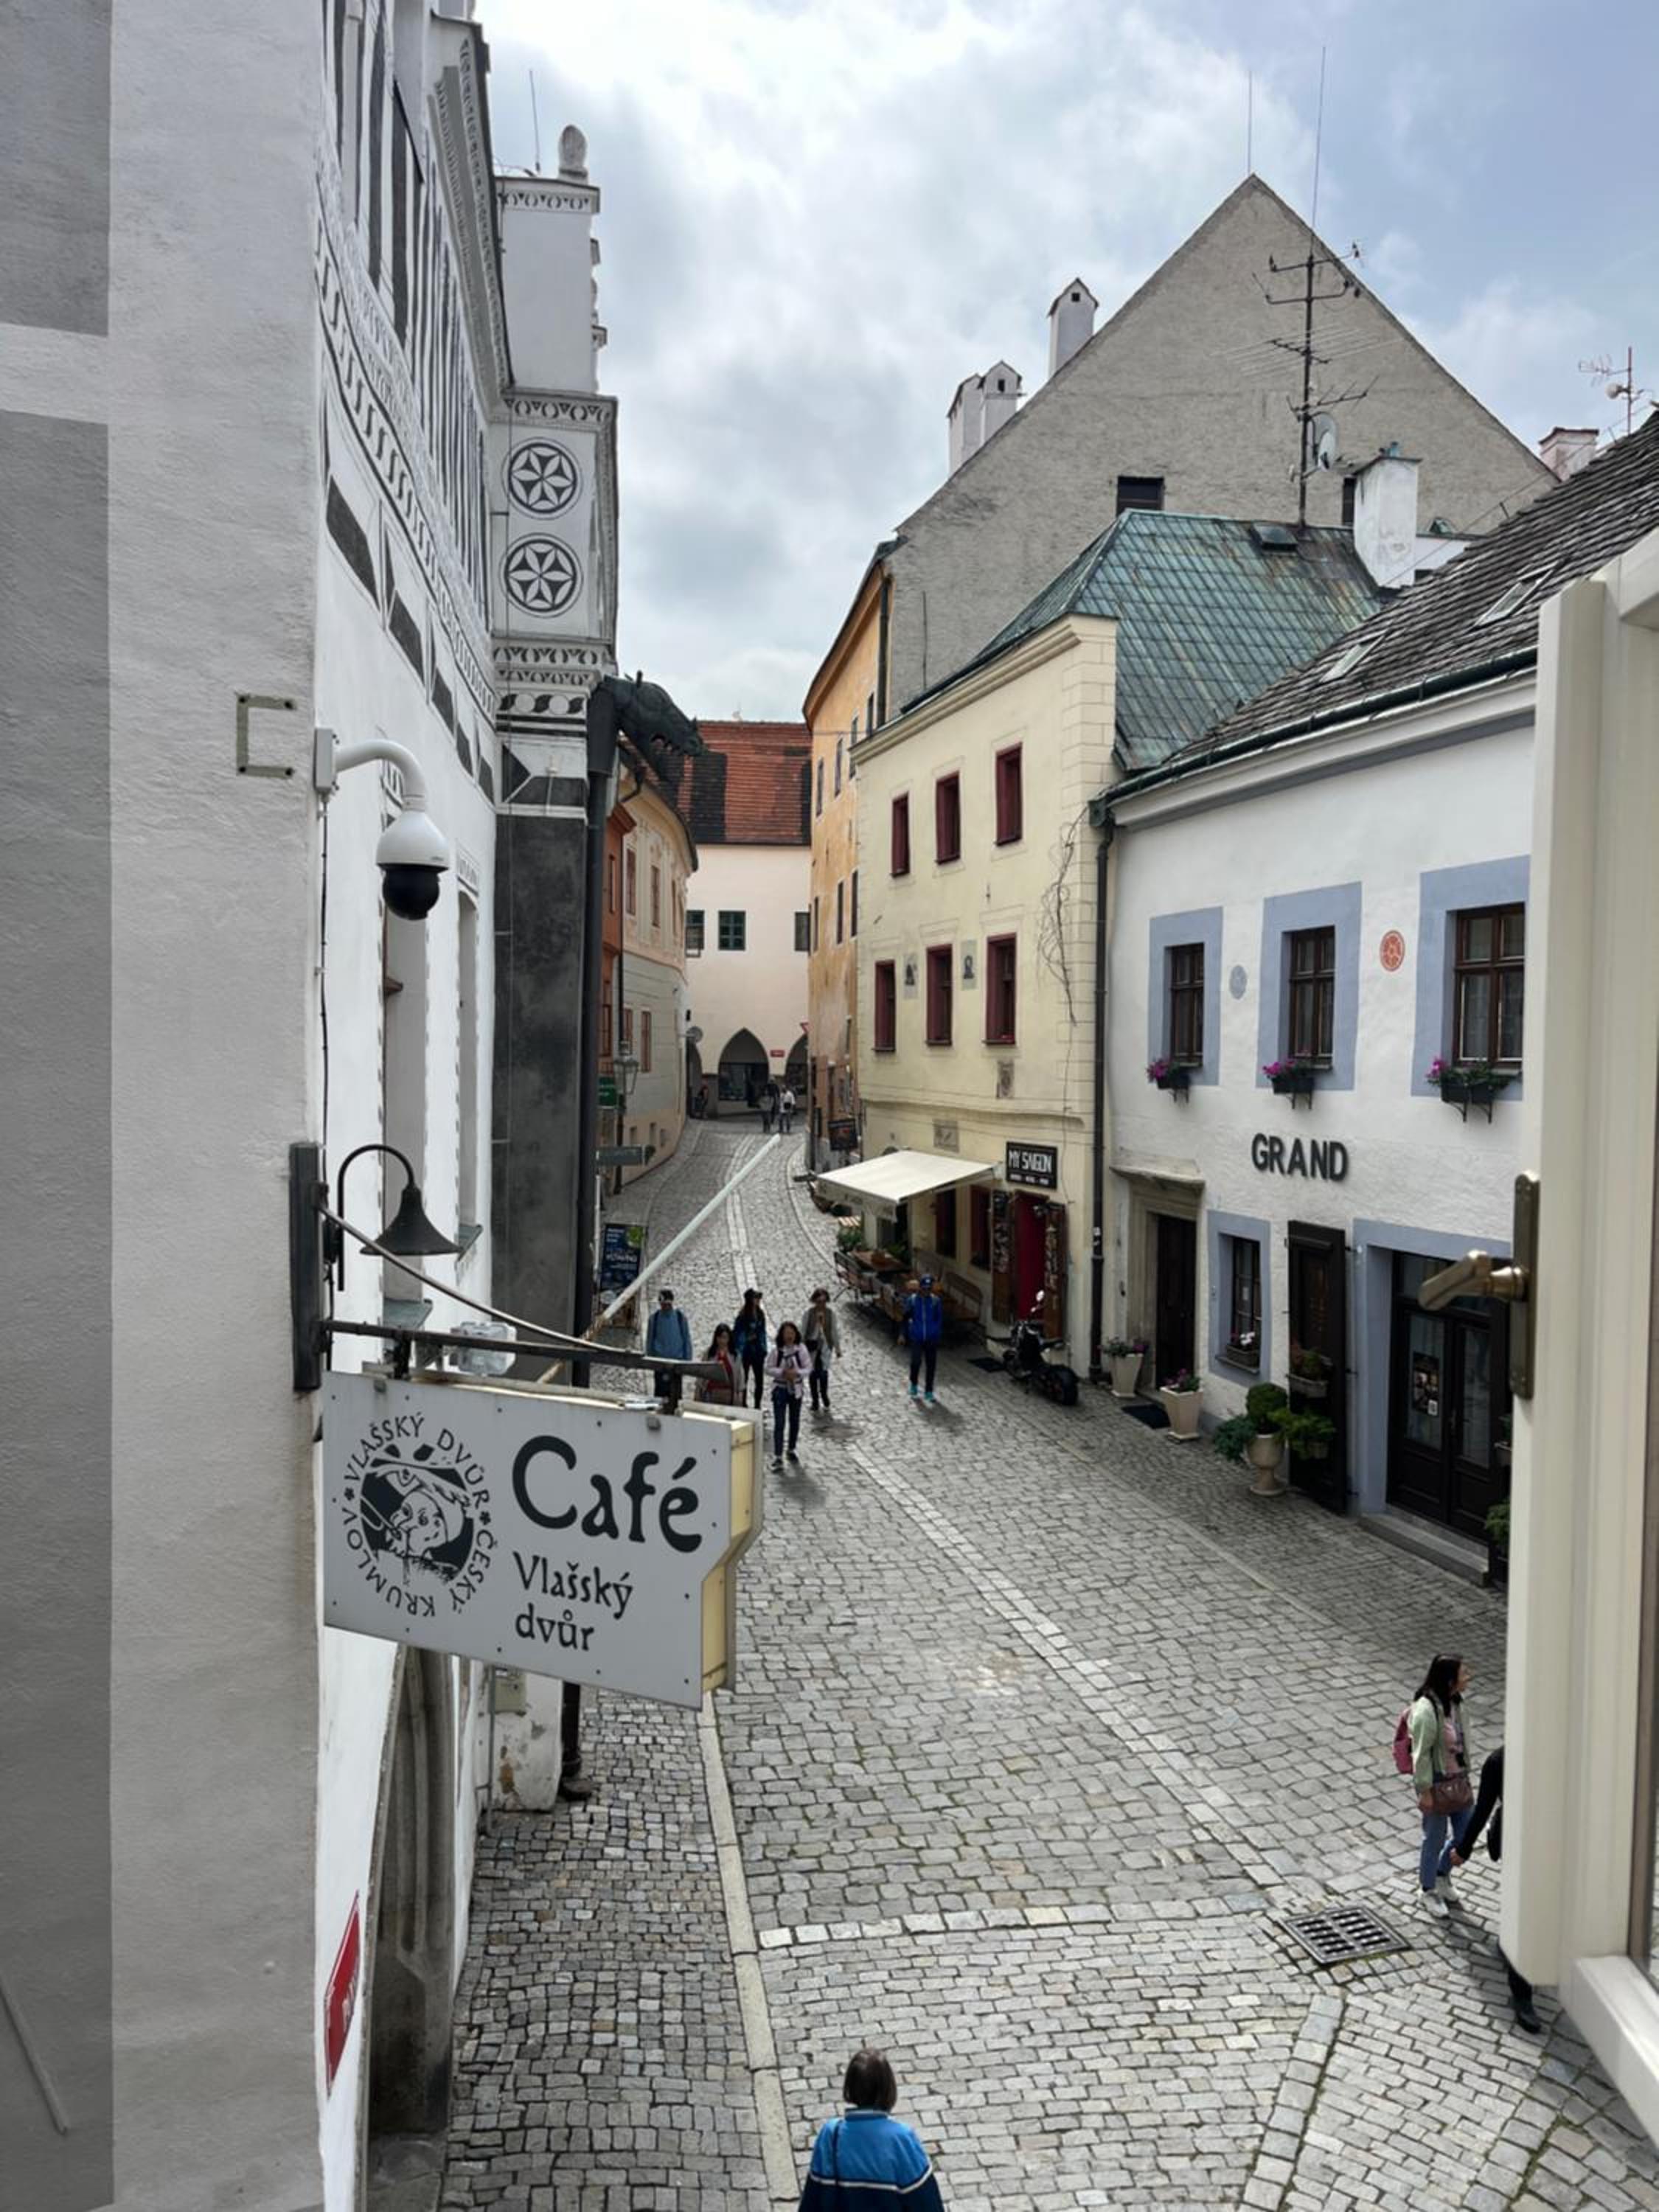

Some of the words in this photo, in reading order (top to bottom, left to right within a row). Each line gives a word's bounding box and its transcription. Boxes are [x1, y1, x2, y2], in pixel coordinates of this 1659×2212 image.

[1251, 1133, 1349, 1182] GRAND
[344, 1412, 425, 1481] VLAŠSKÝ
[436, 1427, 490, 1509] DVŮR
[512, 1435, 702, 1553] Café
[341, 1506, 436, 1617] KRUMLOV
[449, 1528, 498, 1615] ČESKÝ
[512, 1551, 633, 1620] Vlašský
[515, 1602, 594, 1652] dvůr
